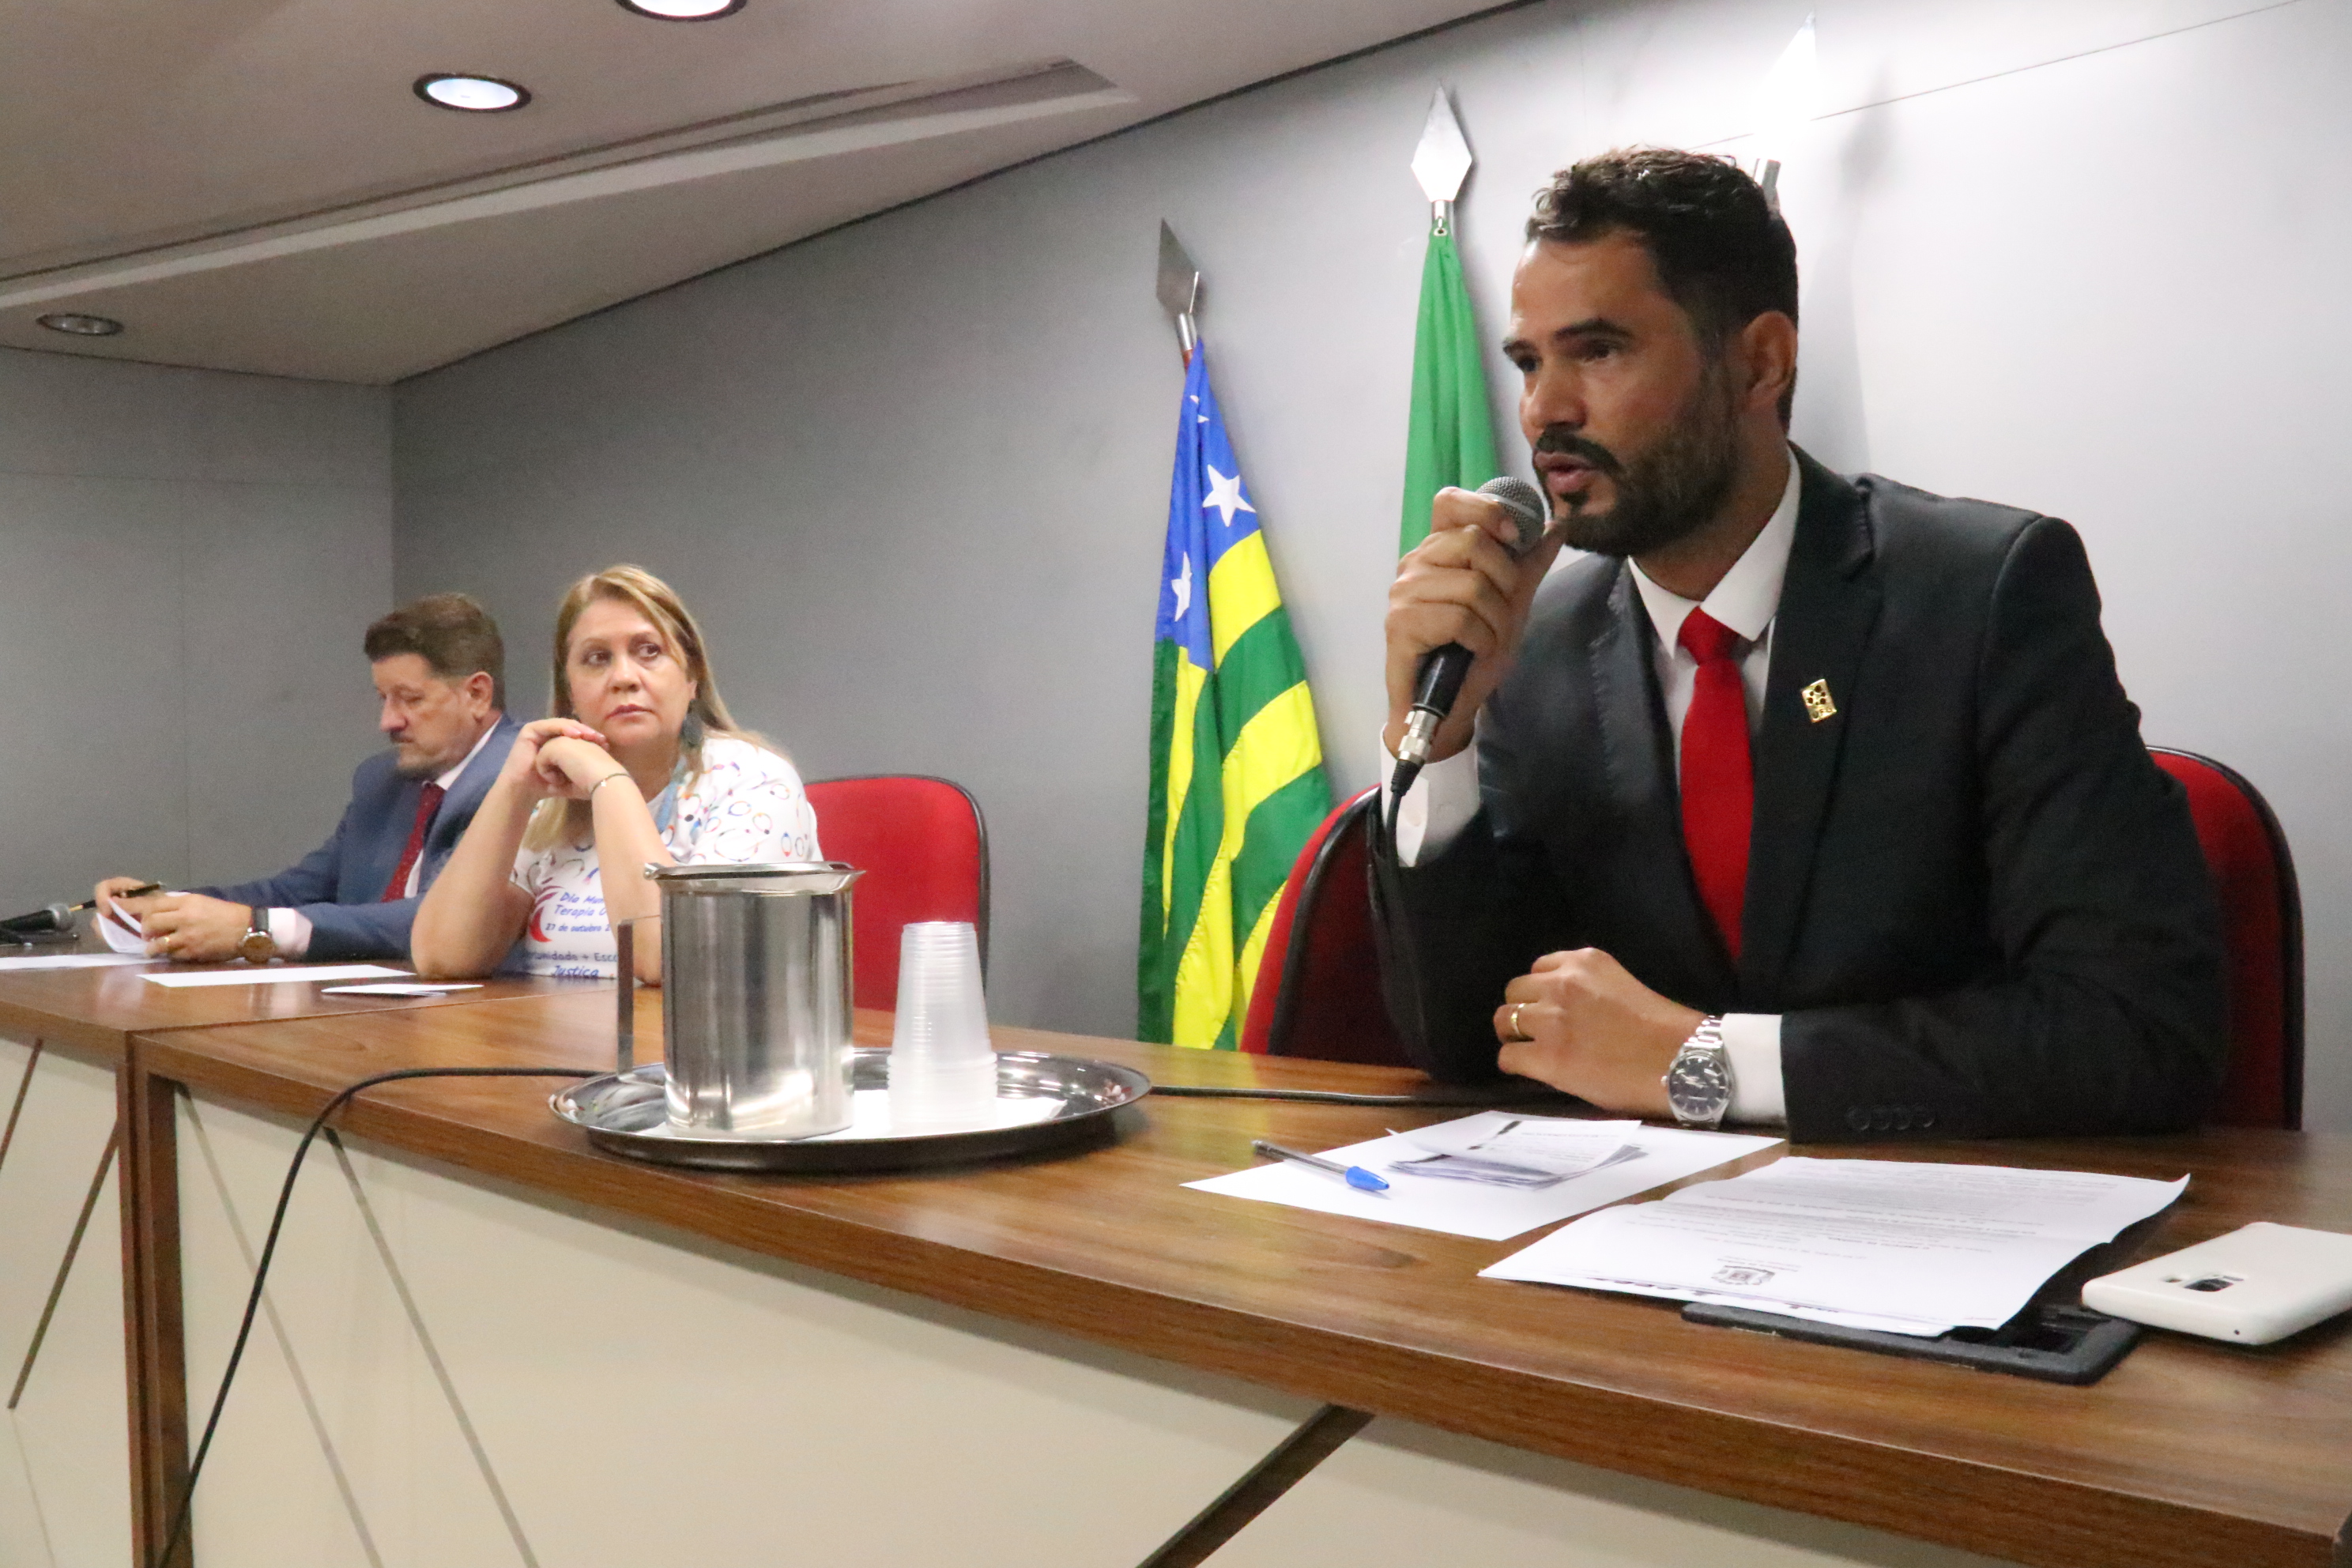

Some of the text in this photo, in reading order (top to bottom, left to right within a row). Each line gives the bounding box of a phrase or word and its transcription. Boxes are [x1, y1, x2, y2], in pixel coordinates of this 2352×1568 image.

[560, 891, 579, 903] Dia
[554, 904, 595, 918] Terapia
[545, 922, 556, 931] 27
[558, 923, 568, 932] de
[570, 924, 602, 933] outubro
